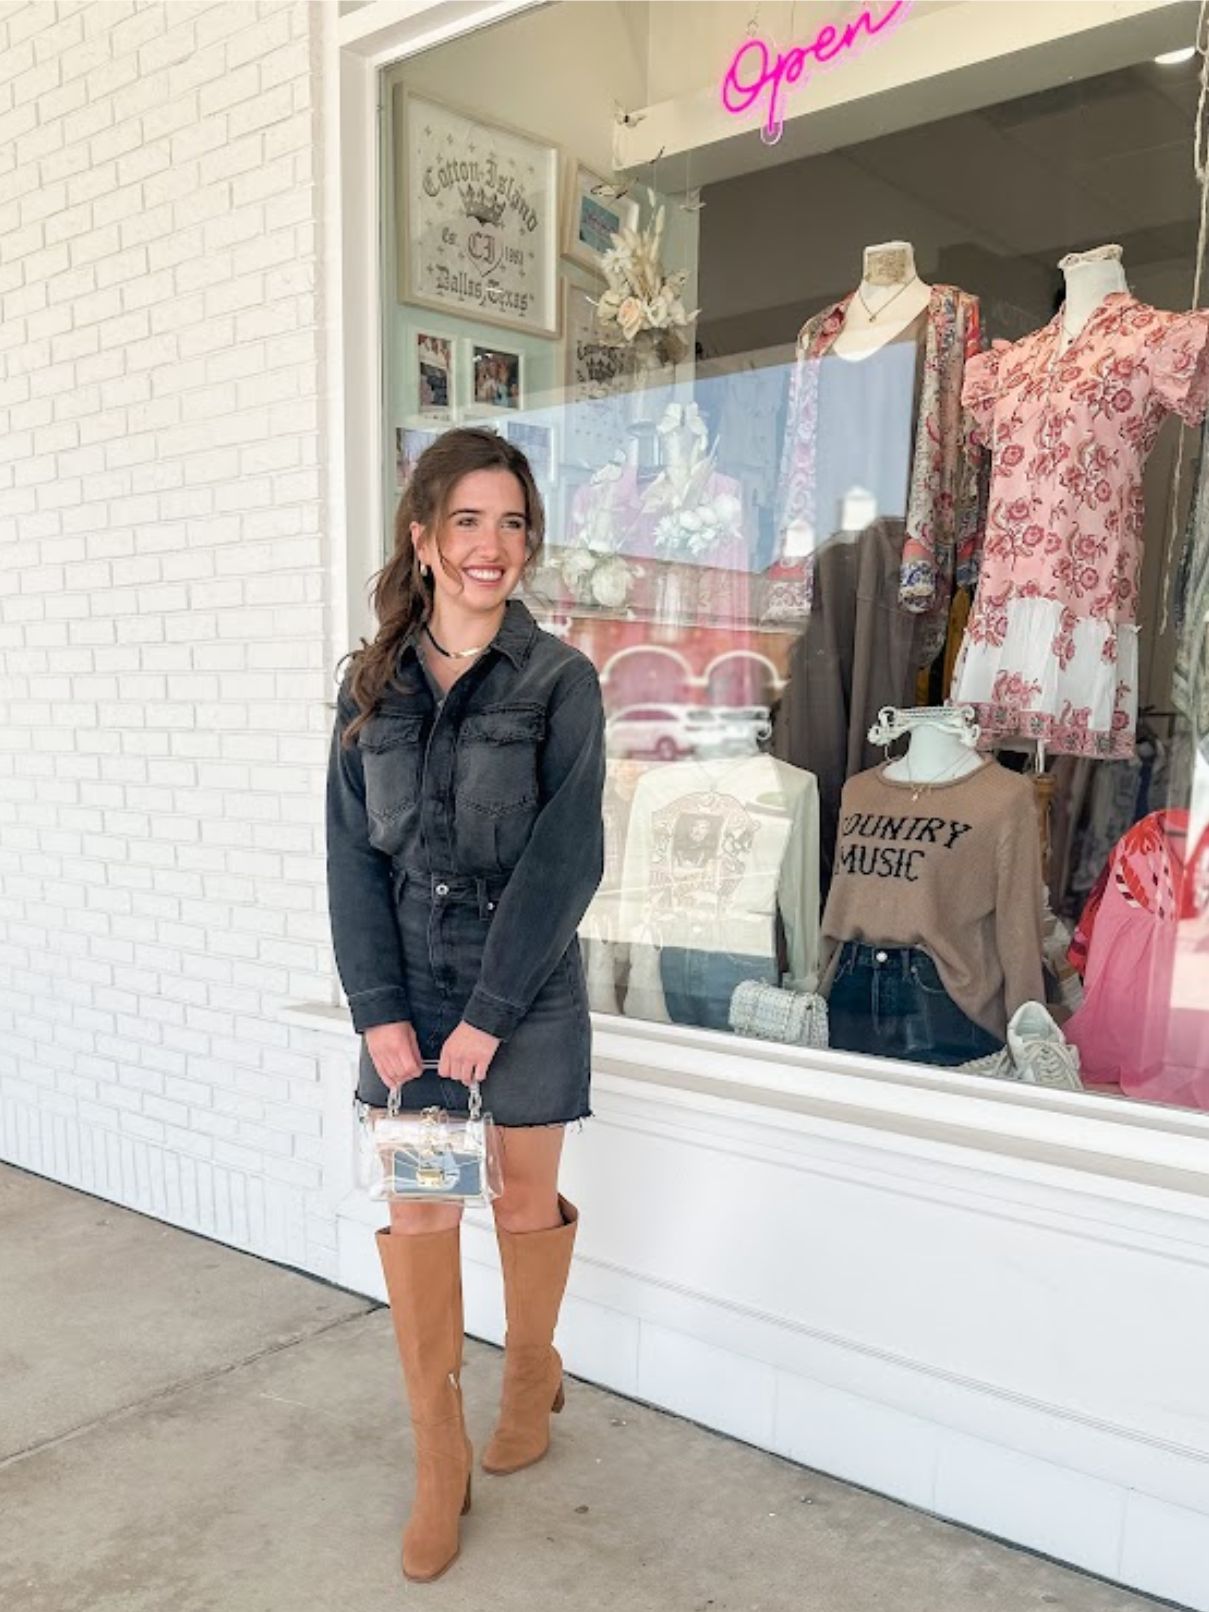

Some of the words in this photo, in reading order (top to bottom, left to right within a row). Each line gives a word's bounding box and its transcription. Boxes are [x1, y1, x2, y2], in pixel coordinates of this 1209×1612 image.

[721, 0, 904, 135] Open
[842, 813, 973, 849] OUNTRY
[834, 843, 925, 882] MUSIC
